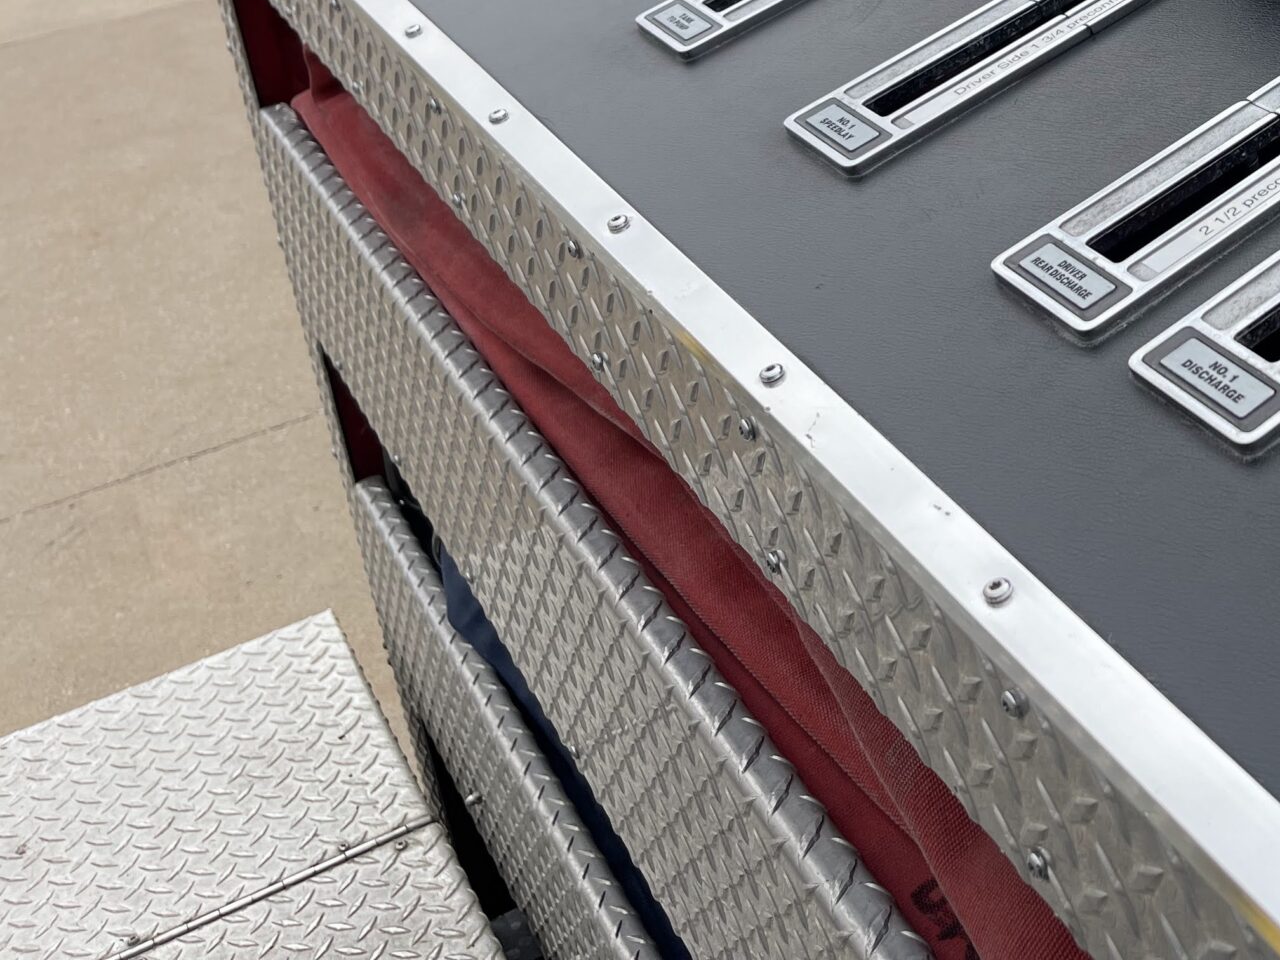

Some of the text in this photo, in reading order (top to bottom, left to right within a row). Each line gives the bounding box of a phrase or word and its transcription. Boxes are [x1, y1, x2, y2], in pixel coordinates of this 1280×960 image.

[954, 68, 997, 96] Driver
[997, 50, 1030, 71] Side
[1041, 27, 1066, 45] 3/4
[820, 117, 855, 140] SPEEDLAY
[1198, 225, 1213, 237] 2
[1214, 206, 1241, 227] 1/2
[1030, 256, 1093, 301] REAR DISCHARGE
[1057, 259, 1088, 282] DRIVER
[1181, 359, 1245, 404] DISCHARGE
[1208, 361, 1228, 378] NO.
